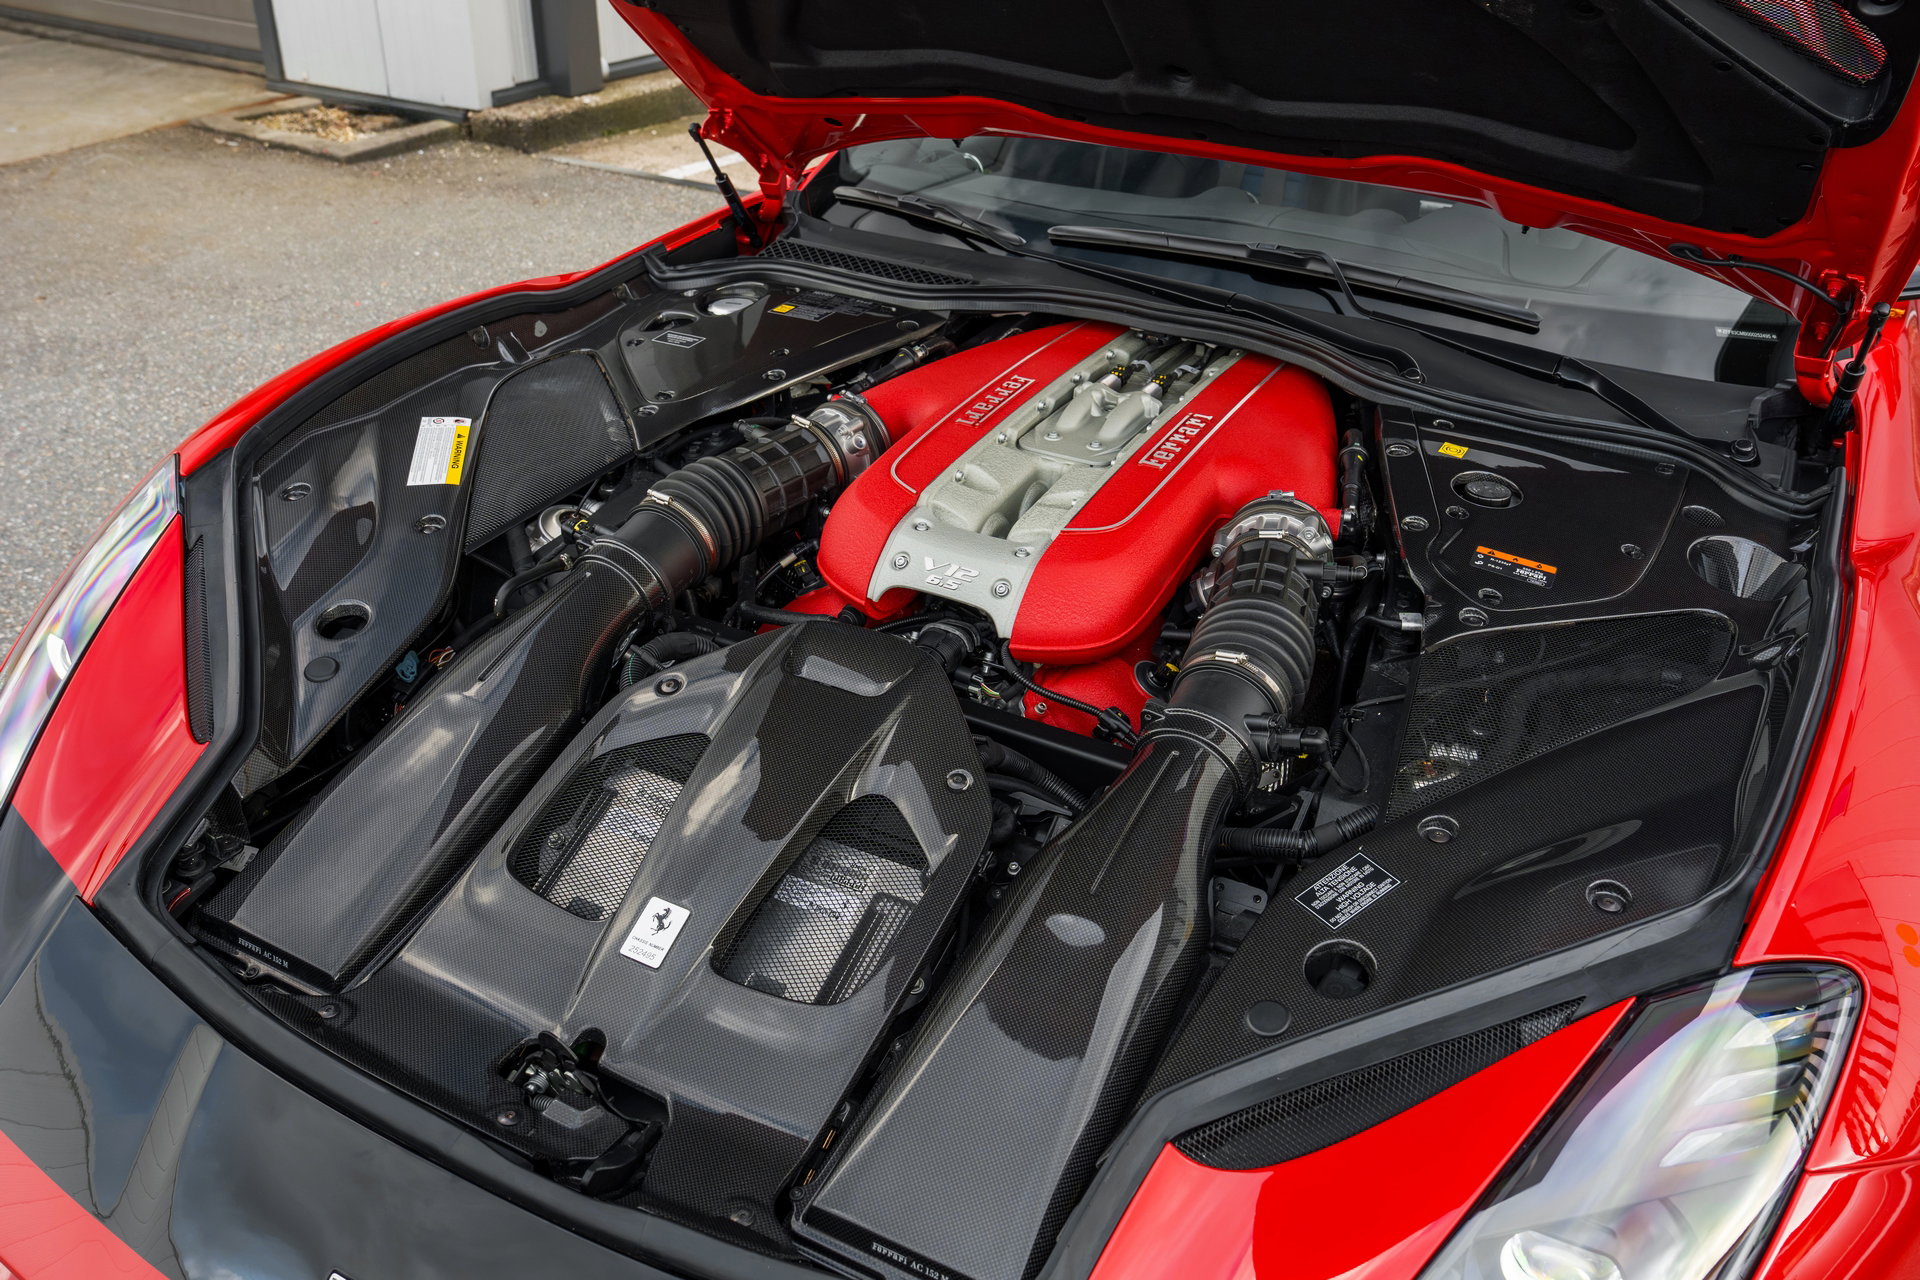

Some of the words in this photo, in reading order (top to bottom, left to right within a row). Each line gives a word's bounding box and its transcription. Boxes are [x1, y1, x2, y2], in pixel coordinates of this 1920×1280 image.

[955, 374, 1036, 427] Ferrari
[1138, 412, 1213, 470] Ferrari
[451, 440, 464, 469] WARNING
[924, 556, 980, 583] V12
[925, 574, 961, 590] 6.5
[1515, 568, 1547, 581] Ferrari
[1313, 865, 1350, 891] ATTENZIONE
[1314, 885, 1331, 897] ALTA
[1327, 866, 1359, 888] TENSIONE
[1335, 881, 1365, 903] WARNING
[1335, 899, 1353, 911] HIGH
[1350, 881, 1377, 901] VOLTAGE
[628, 945, 657, 961] 252495
[632, 935, 649, 946] CHASSIS
[649, 942, 665, 952] NUMBER
[263, 951, 272, 960] AC
[272, 954, 282, 965] 152
[282, 961, 289, 969] M
[872, 1242, 908, 1265] Ferrari
[911, 1261, 923, 1273] AC
[925, 1267, 939, 1280] 152
